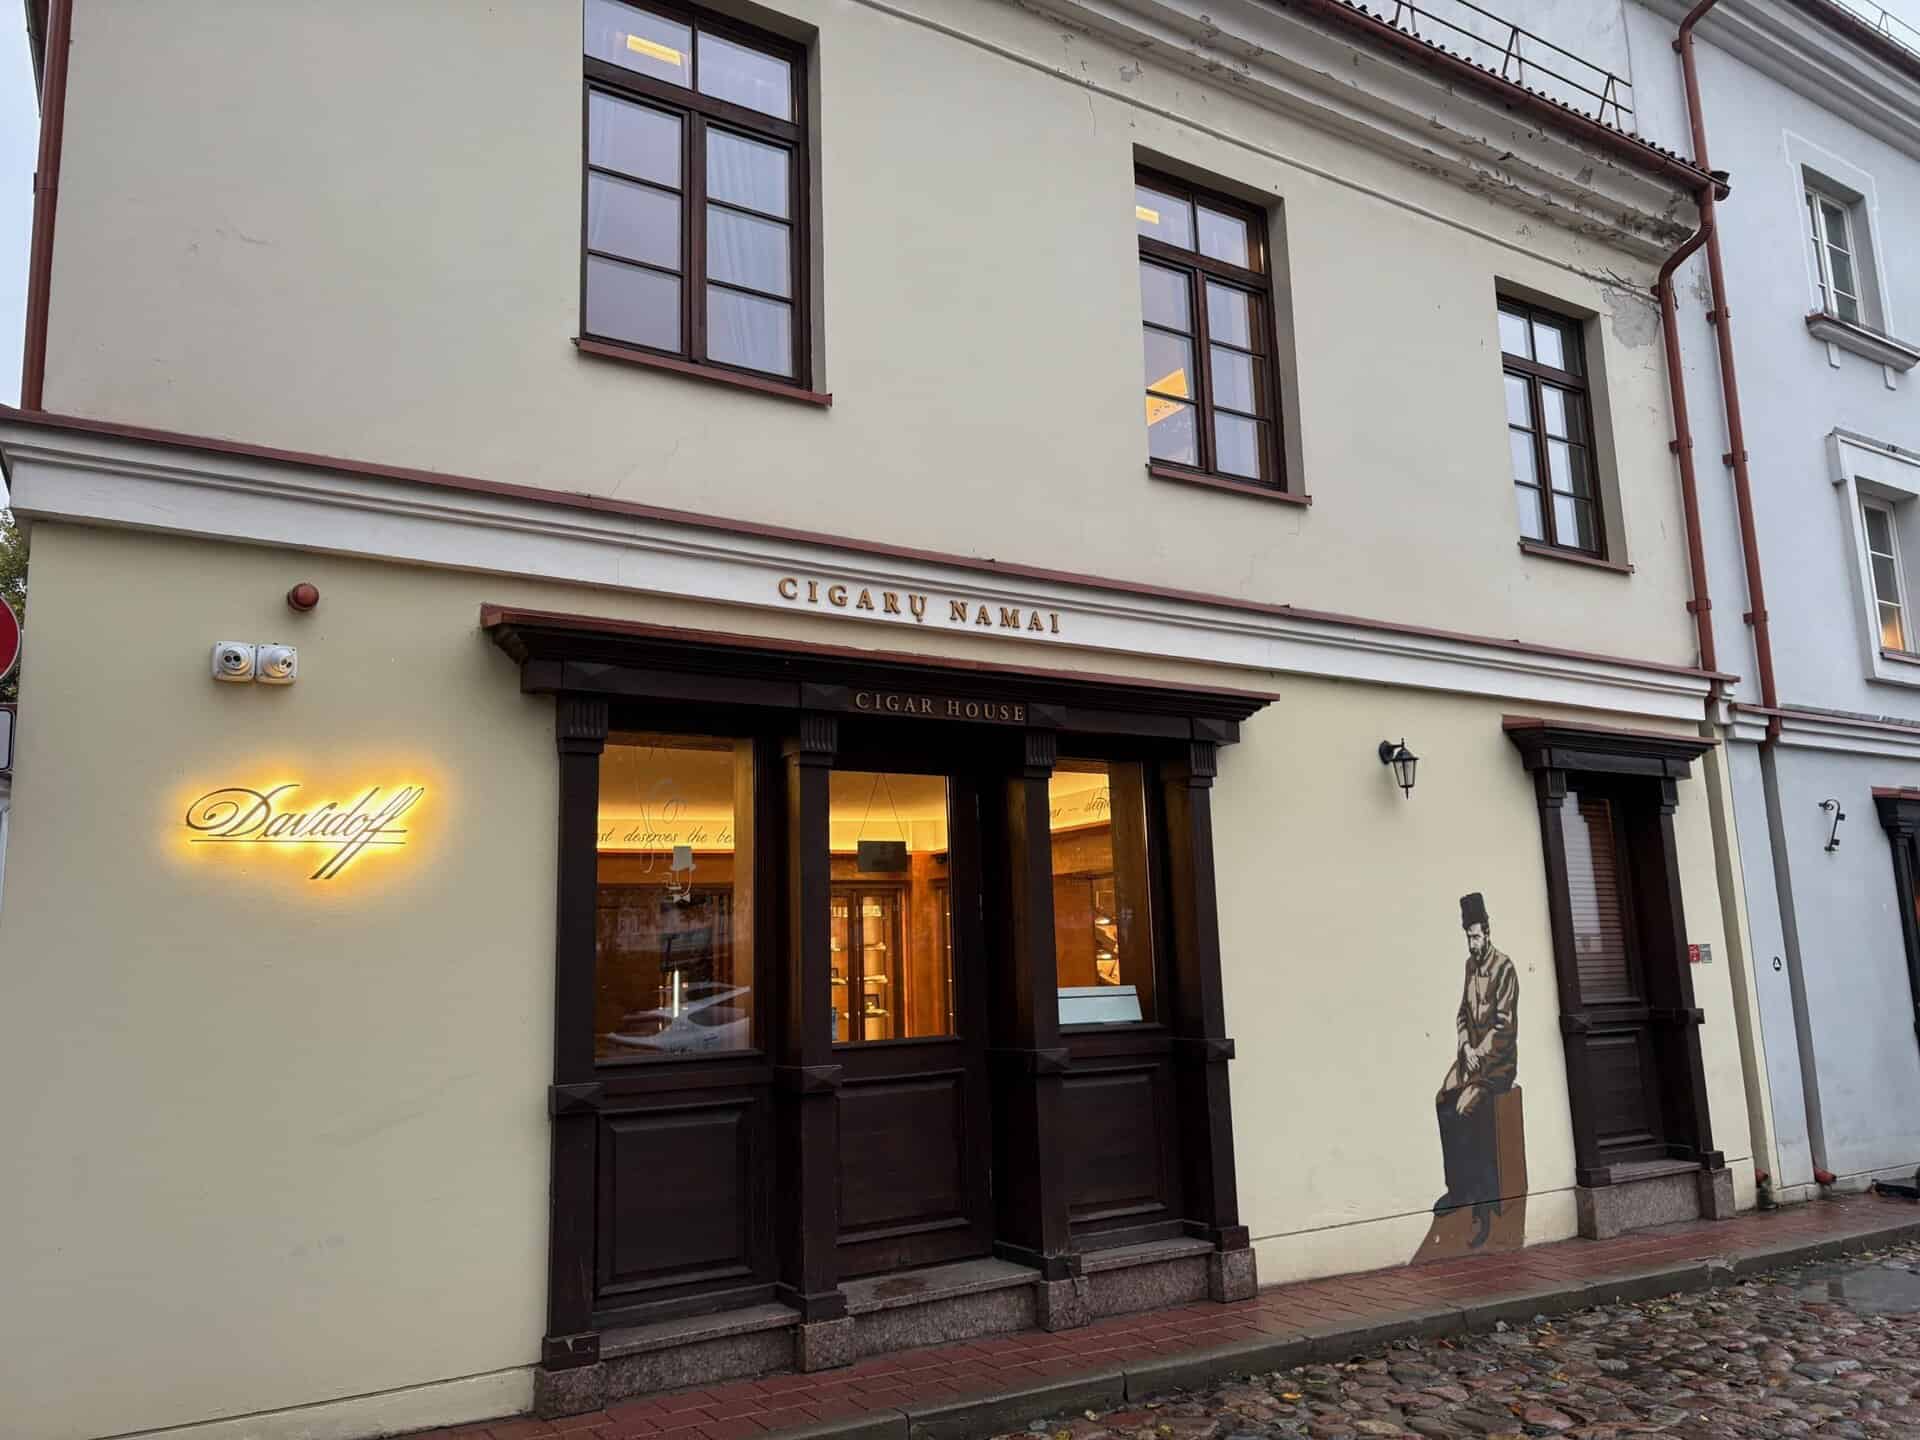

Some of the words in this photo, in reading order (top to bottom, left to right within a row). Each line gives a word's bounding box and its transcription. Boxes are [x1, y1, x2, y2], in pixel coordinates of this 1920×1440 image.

[779, 577, 927, 622] CIGARŲ
[950, 600, 1060, 633] NAMAI
[855, 692, 933, 713] CIGAR
[947, 700, 1025, 721] HOUSE
[186, 784, 425, 880] Davidoff
[624, 826, 679, 842] deserves
[687, 825, 707, 842] the
